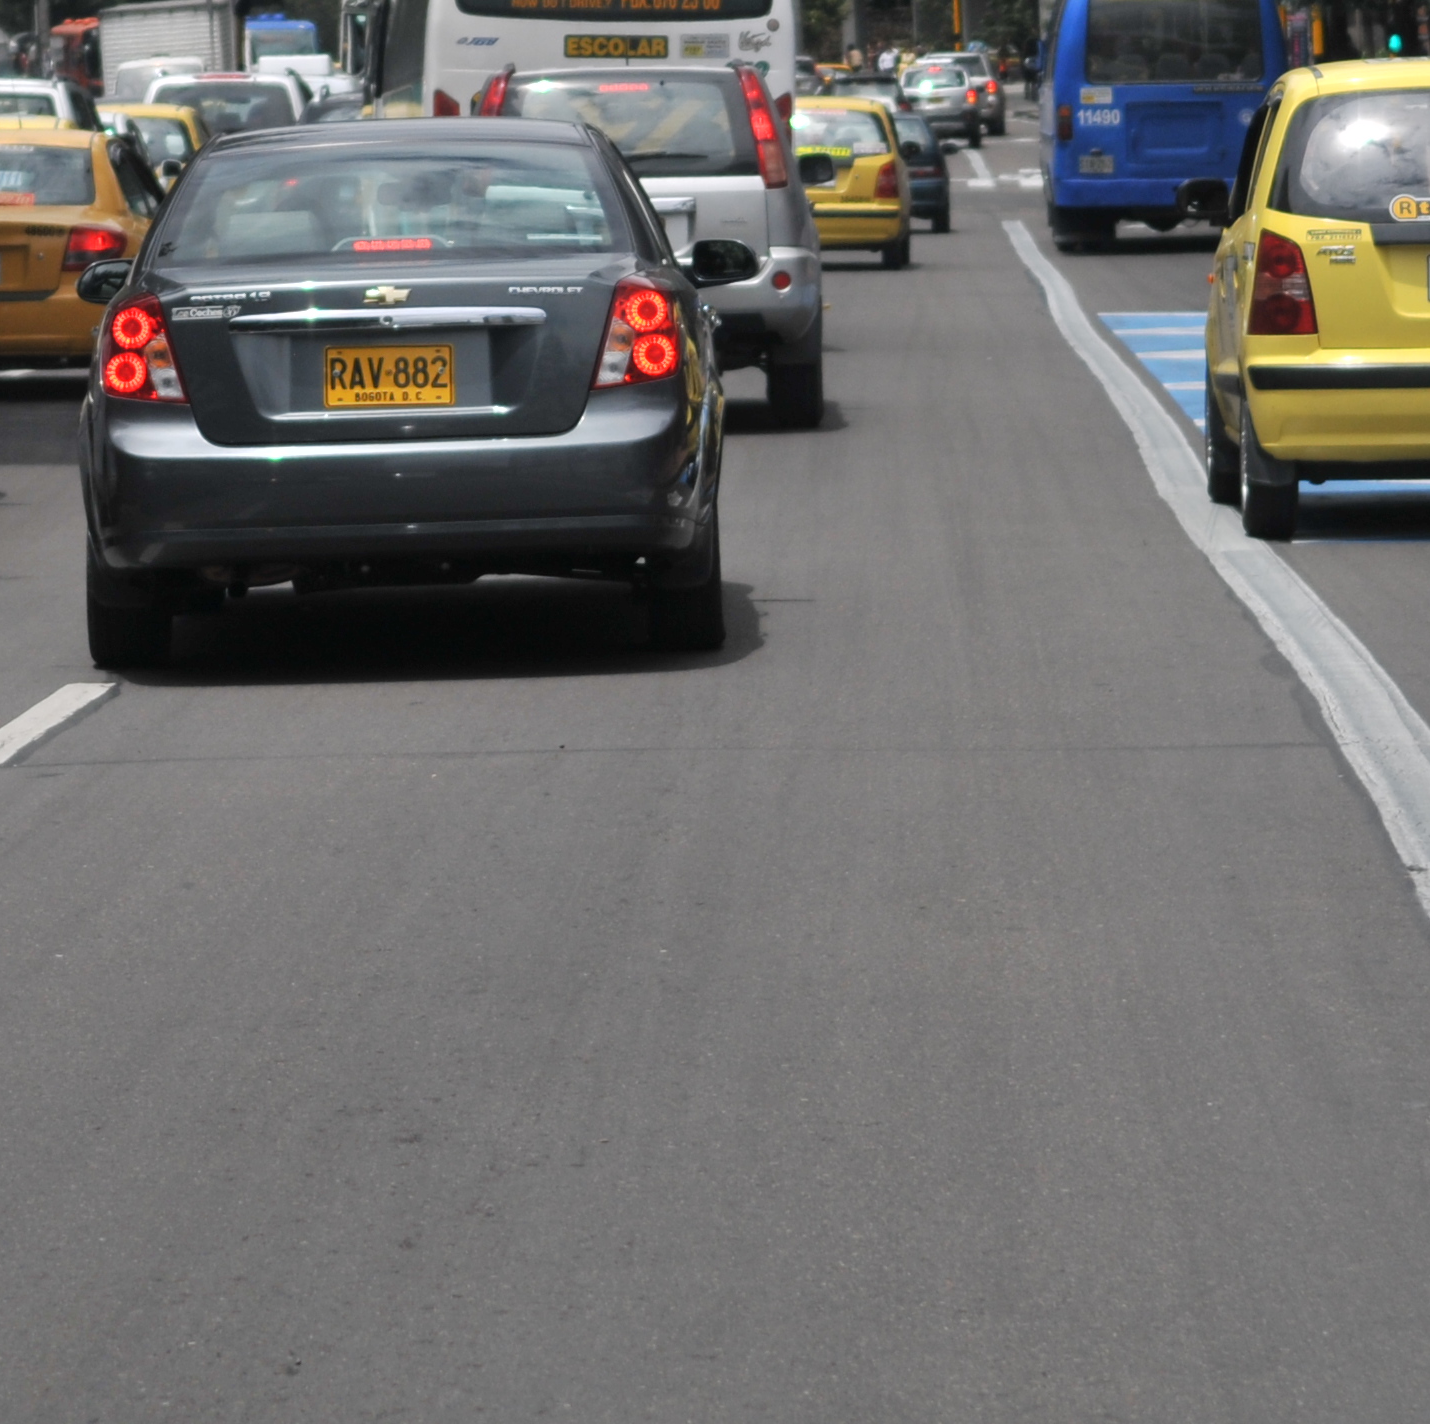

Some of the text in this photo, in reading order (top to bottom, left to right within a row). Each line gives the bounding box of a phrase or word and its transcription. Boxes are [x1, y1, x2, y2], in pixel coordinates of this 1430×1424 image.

[567, 36, 667, 56] ESCOLAR
[1076, 109, 1121, 125] 11490
[1399, 201, 1412, 215] R
[354, 391, 395, 402] BOGOTA
